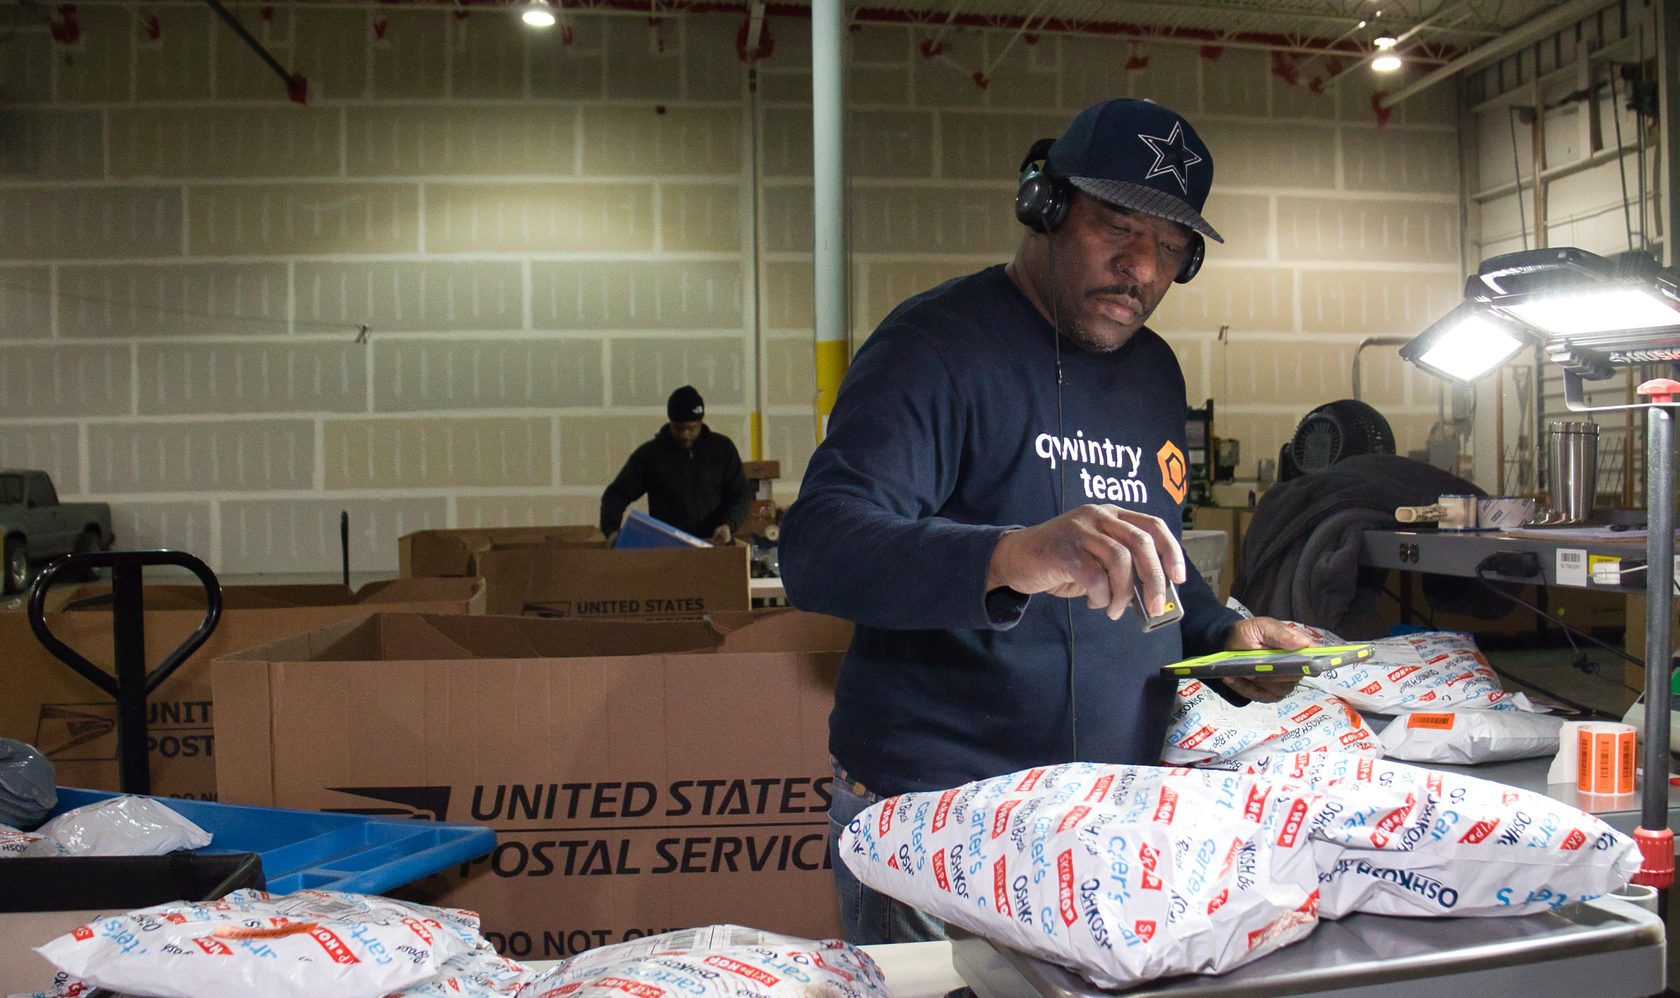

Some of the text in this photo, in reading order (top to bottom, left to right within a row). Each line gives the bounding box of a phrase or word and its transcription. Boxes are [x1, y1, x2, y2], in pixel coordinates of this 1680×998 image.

[1035, 430, 1142, 478] qwintry
[1080, 467, 1148, 504] team
[577, 598, 704, 614] UNITED STATES
[470, 776, 834, 821] UNITED STATES
[543, 929, 613, 957] NOT
[707, 955, 776, 985] SKIP HOP
